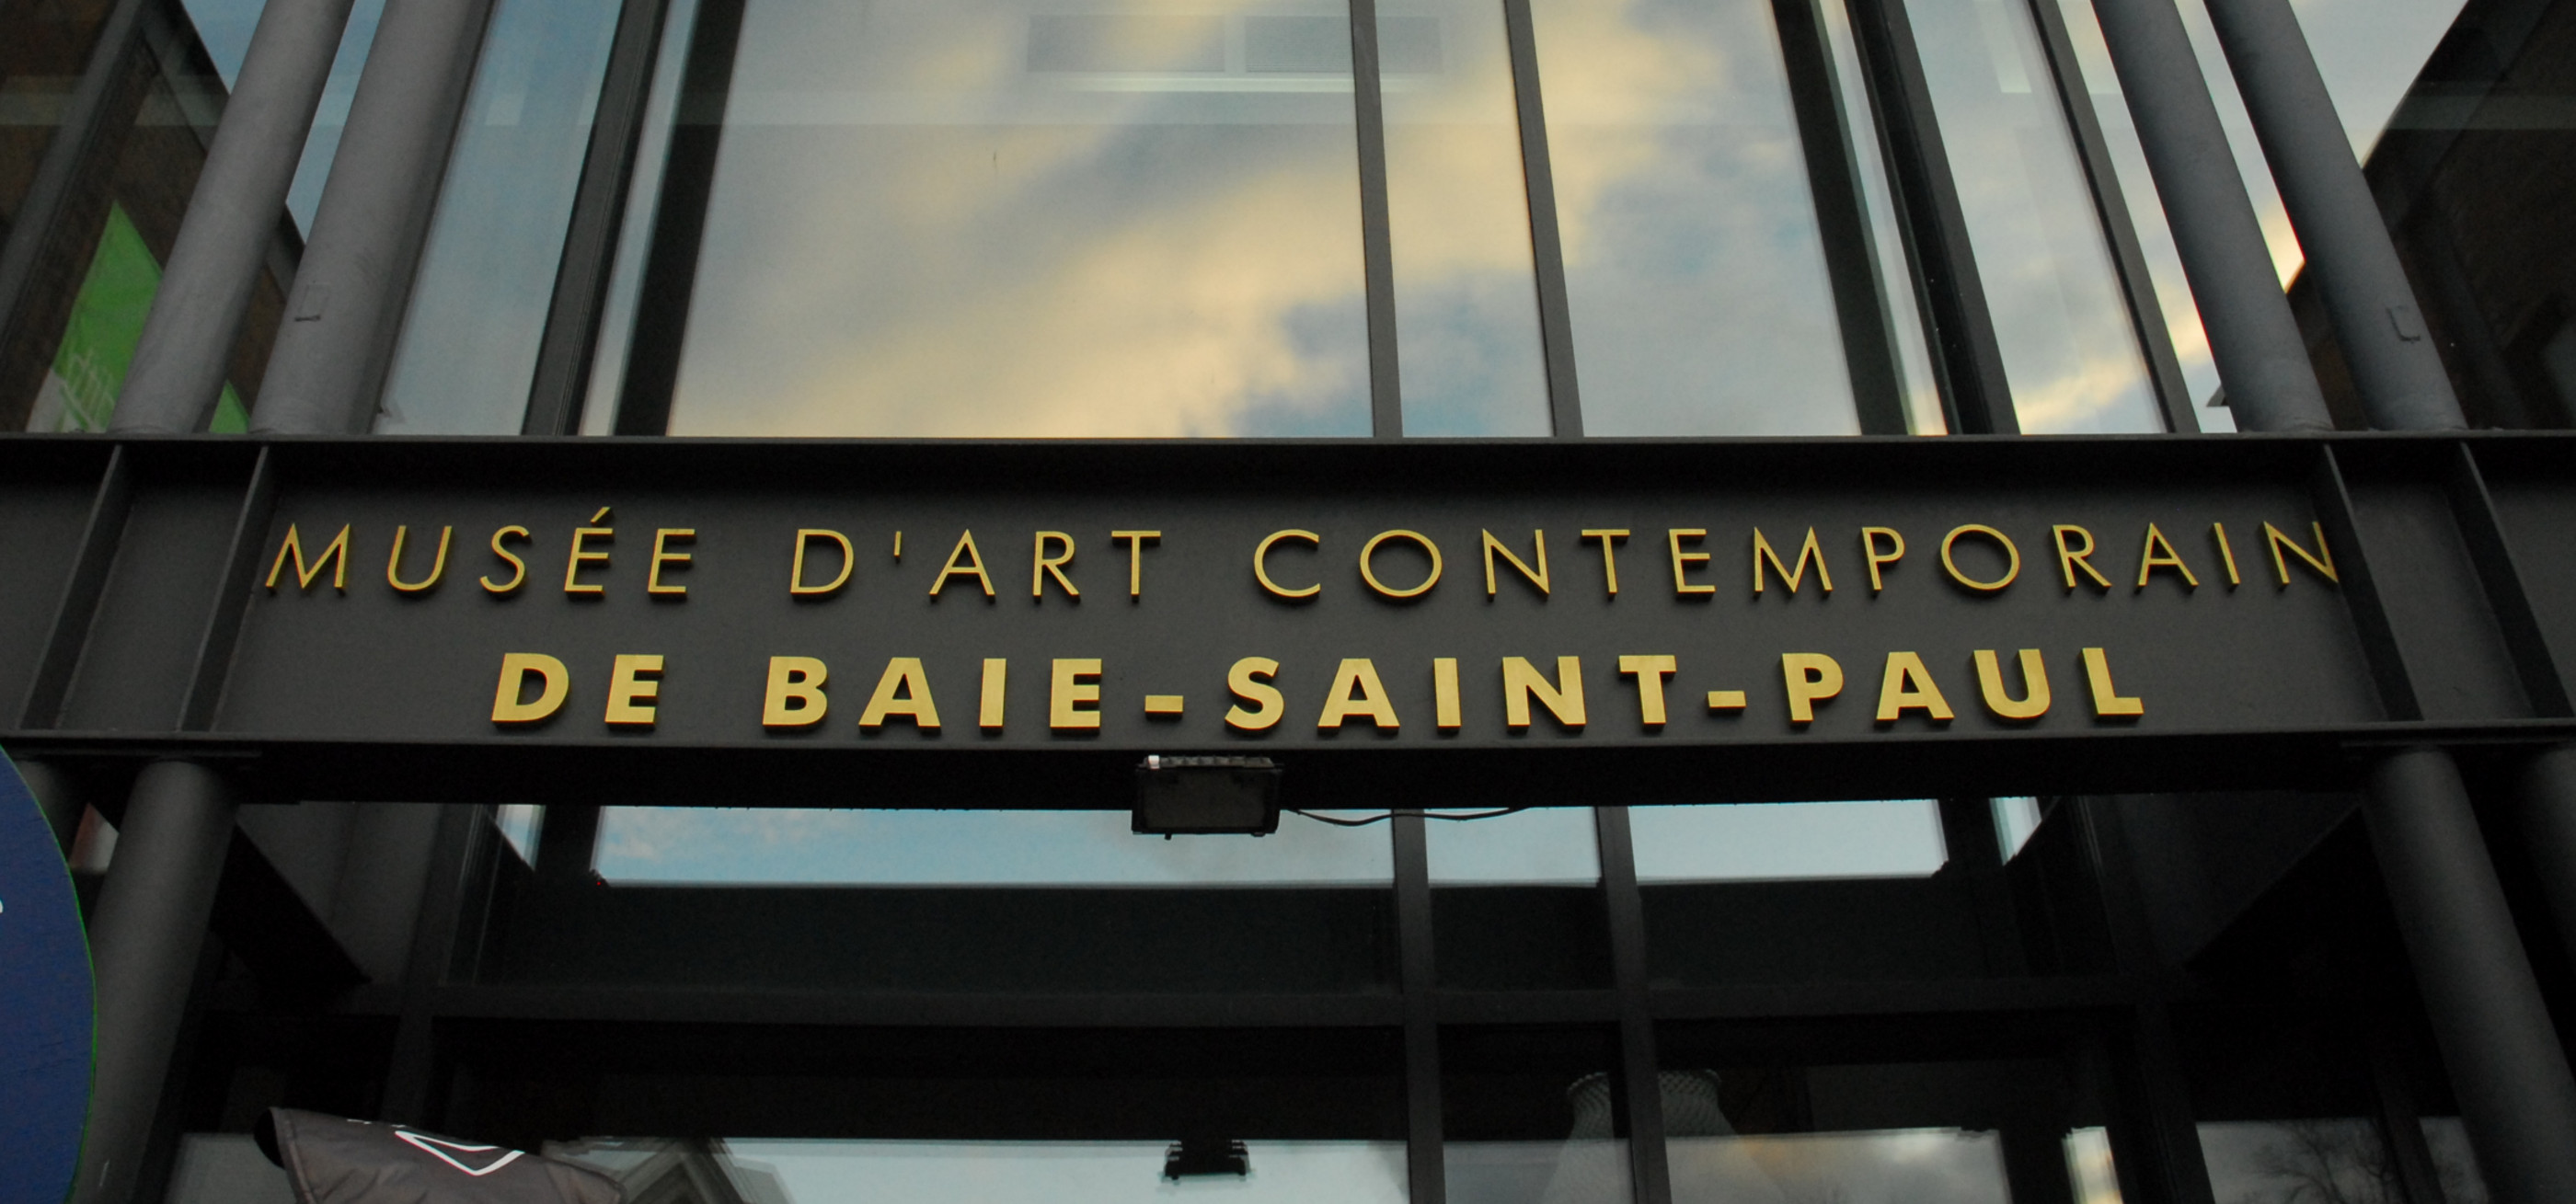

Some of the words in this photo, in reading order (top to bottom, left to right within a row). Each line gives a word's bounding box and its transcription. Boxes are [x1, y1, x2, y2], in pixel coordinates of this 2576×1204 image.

[265, 506, 696, 595] MUSÉE
[789, 528, 1163, 598] D'ART
[1252, 521, 2340, 599] CONTEMPORAIN
[490, 652, 664, 725] DE
[761, 647, 2145, 730] BAIE-SAINT-PAUL
